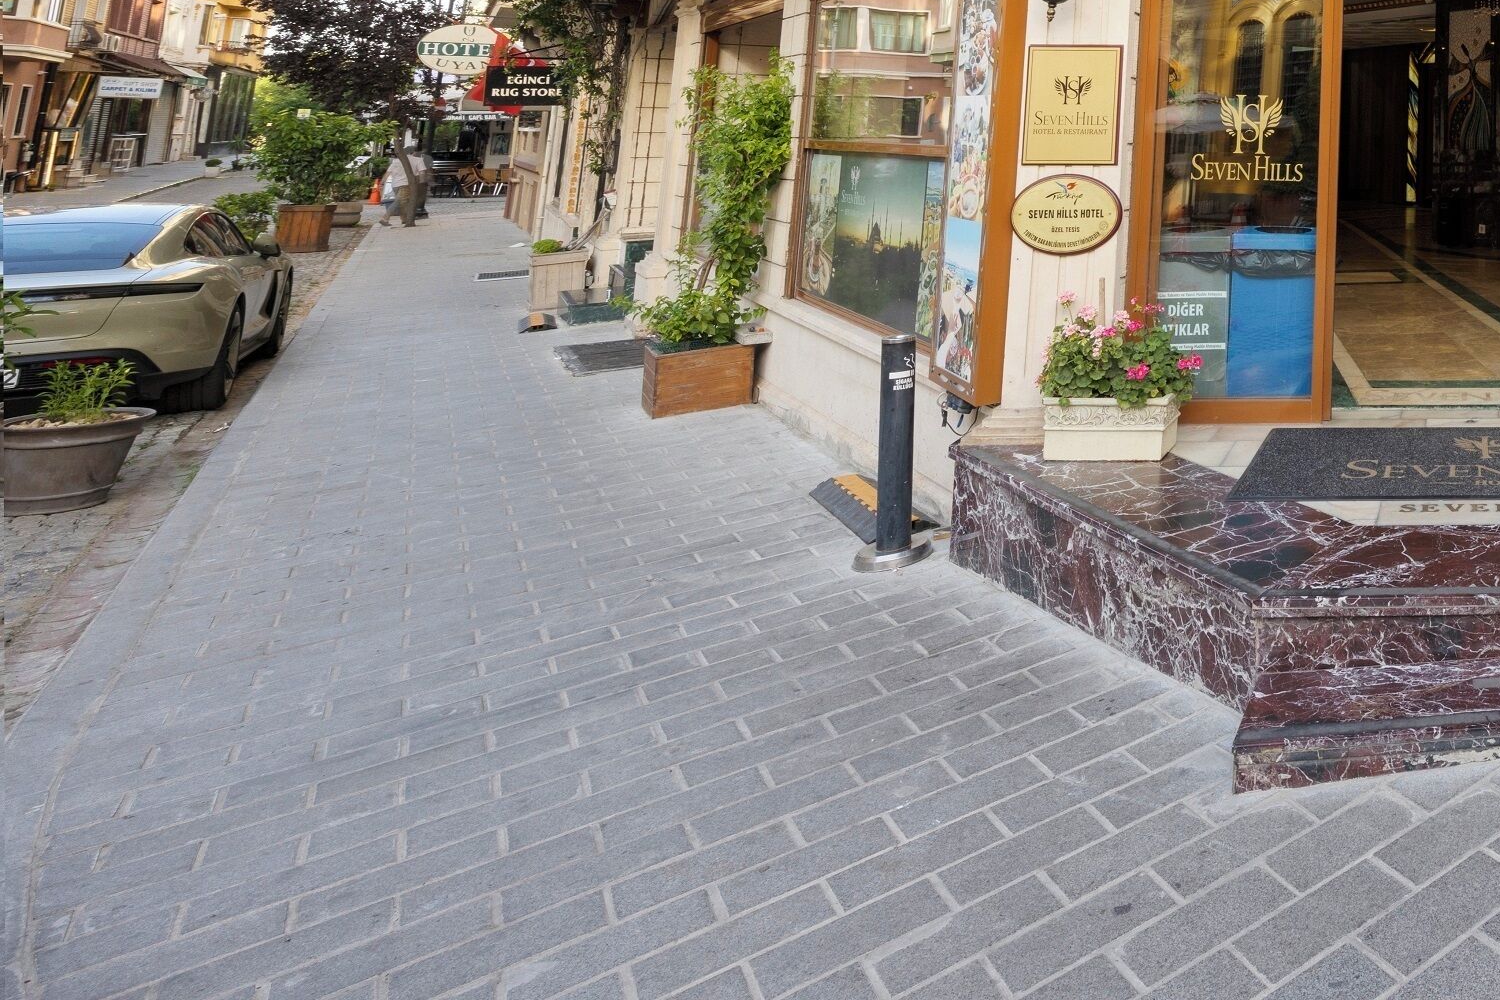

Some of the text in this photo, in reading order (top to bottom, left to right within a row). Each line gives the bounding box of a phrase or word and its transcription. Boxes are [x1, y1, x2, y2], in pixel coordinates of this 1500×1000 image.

[422, 42, 491, 56] HOTE
[506, 74, 550, 85] EĞİNCİ
[491, 88, 562, 97] RUG STORE
[1028, 209, 1055, 219] SEVEN
[1080, 208, 1105, 219] HOTEL
[1167, 302, 1204, 317] DİĞER
